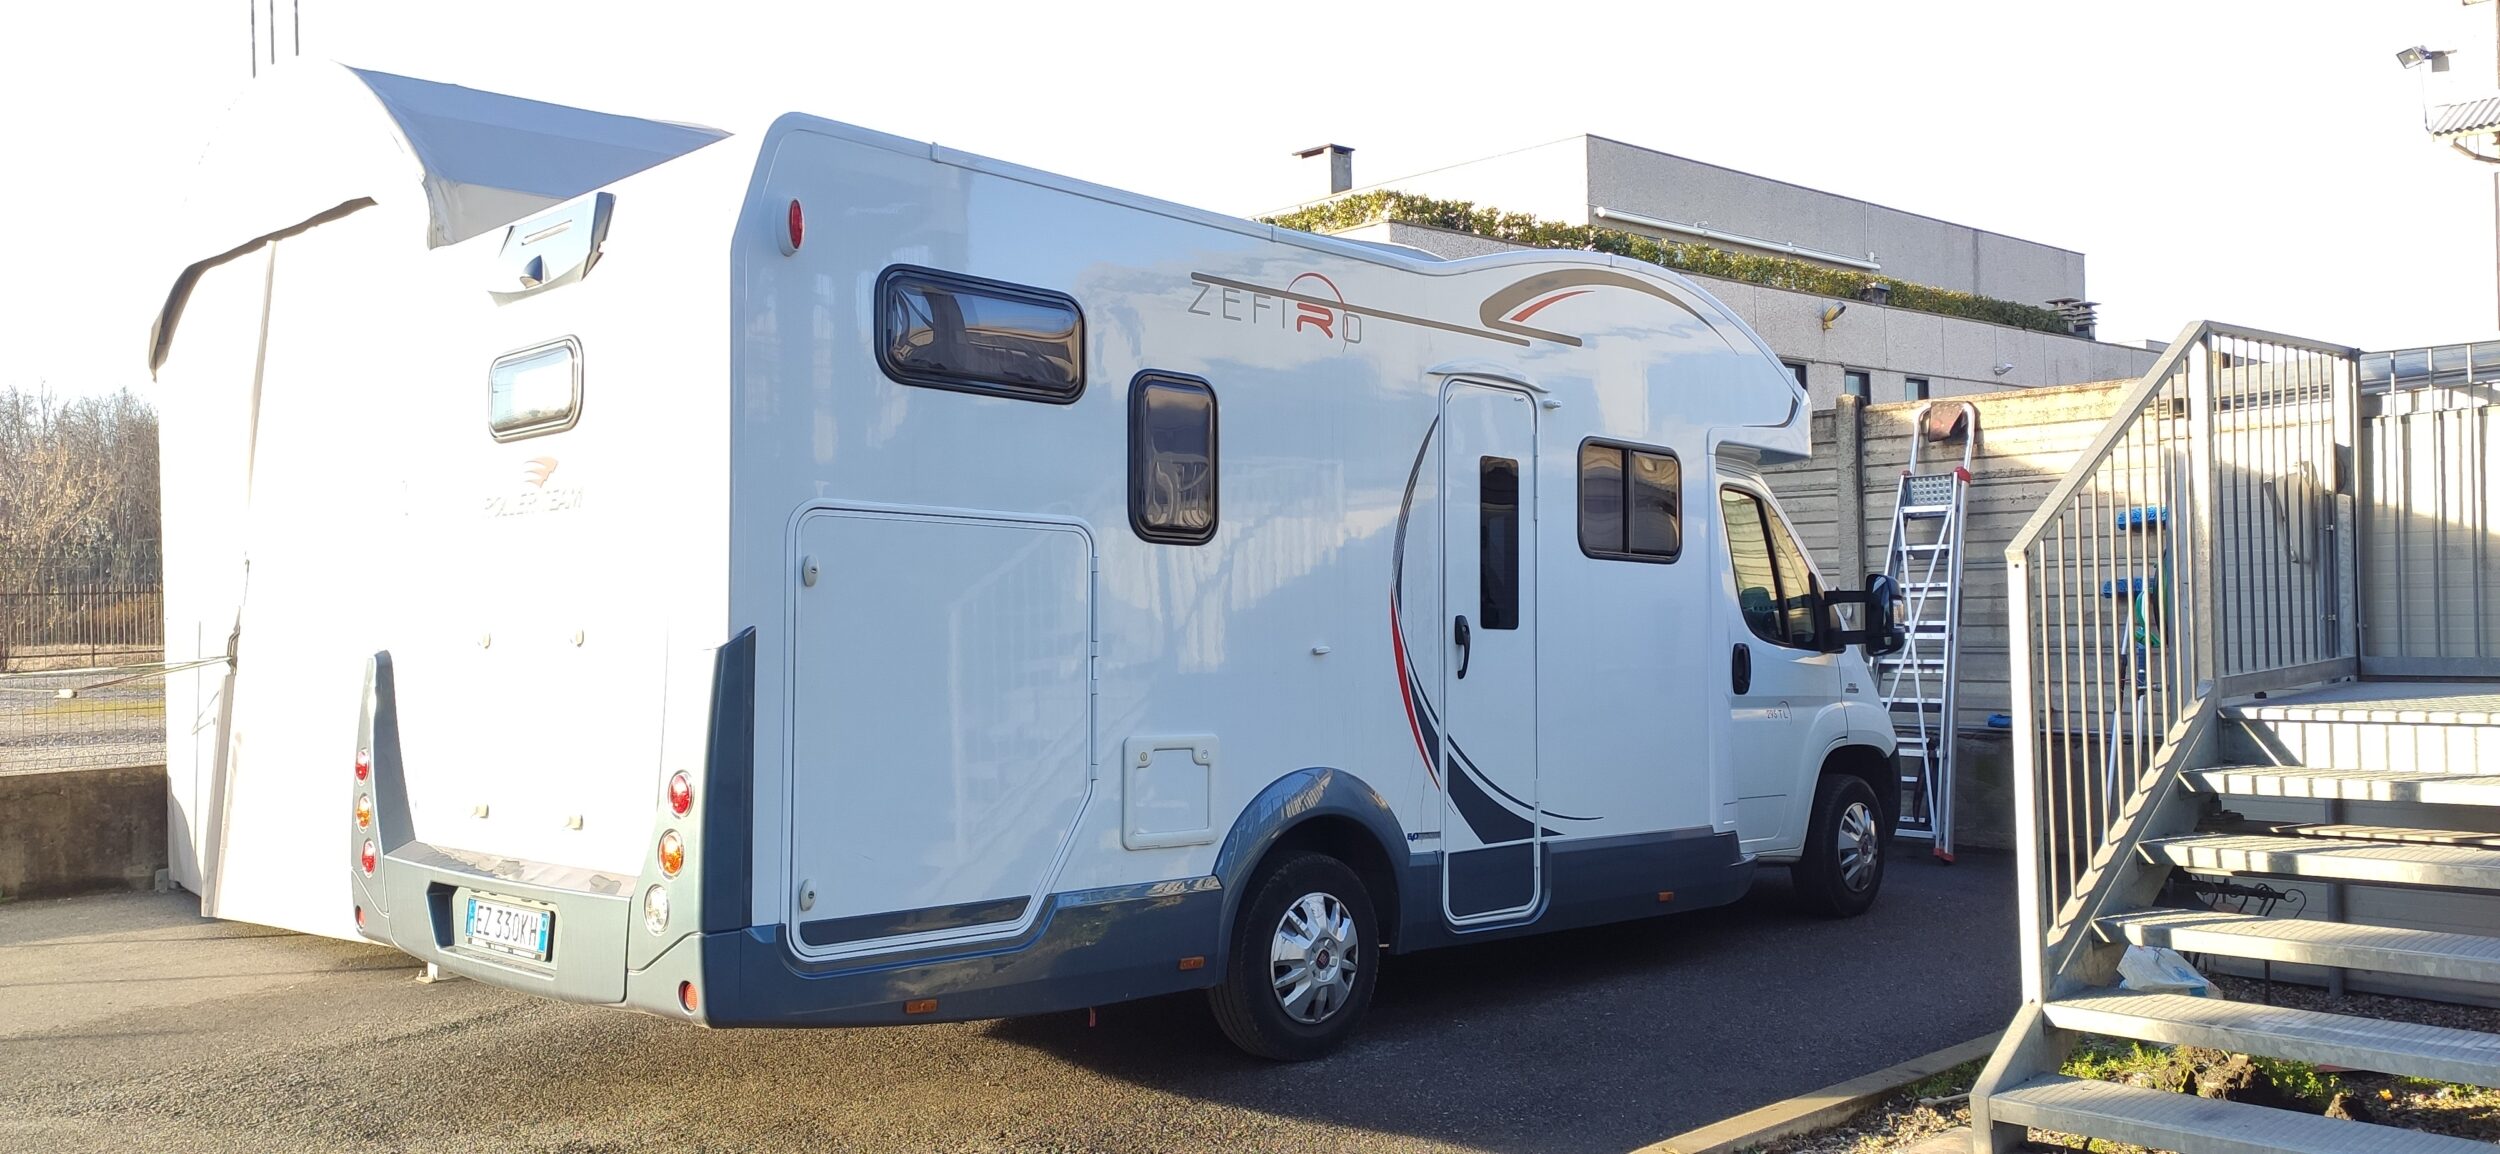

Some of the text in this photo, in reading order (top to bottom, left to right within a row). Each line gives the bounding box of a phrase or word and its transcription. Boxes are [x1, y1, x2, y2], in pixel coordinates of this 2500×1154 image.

[1187, 280, 1362, 344] ZEFIRO
[475, 904, 539, 947] EZ 330KH
